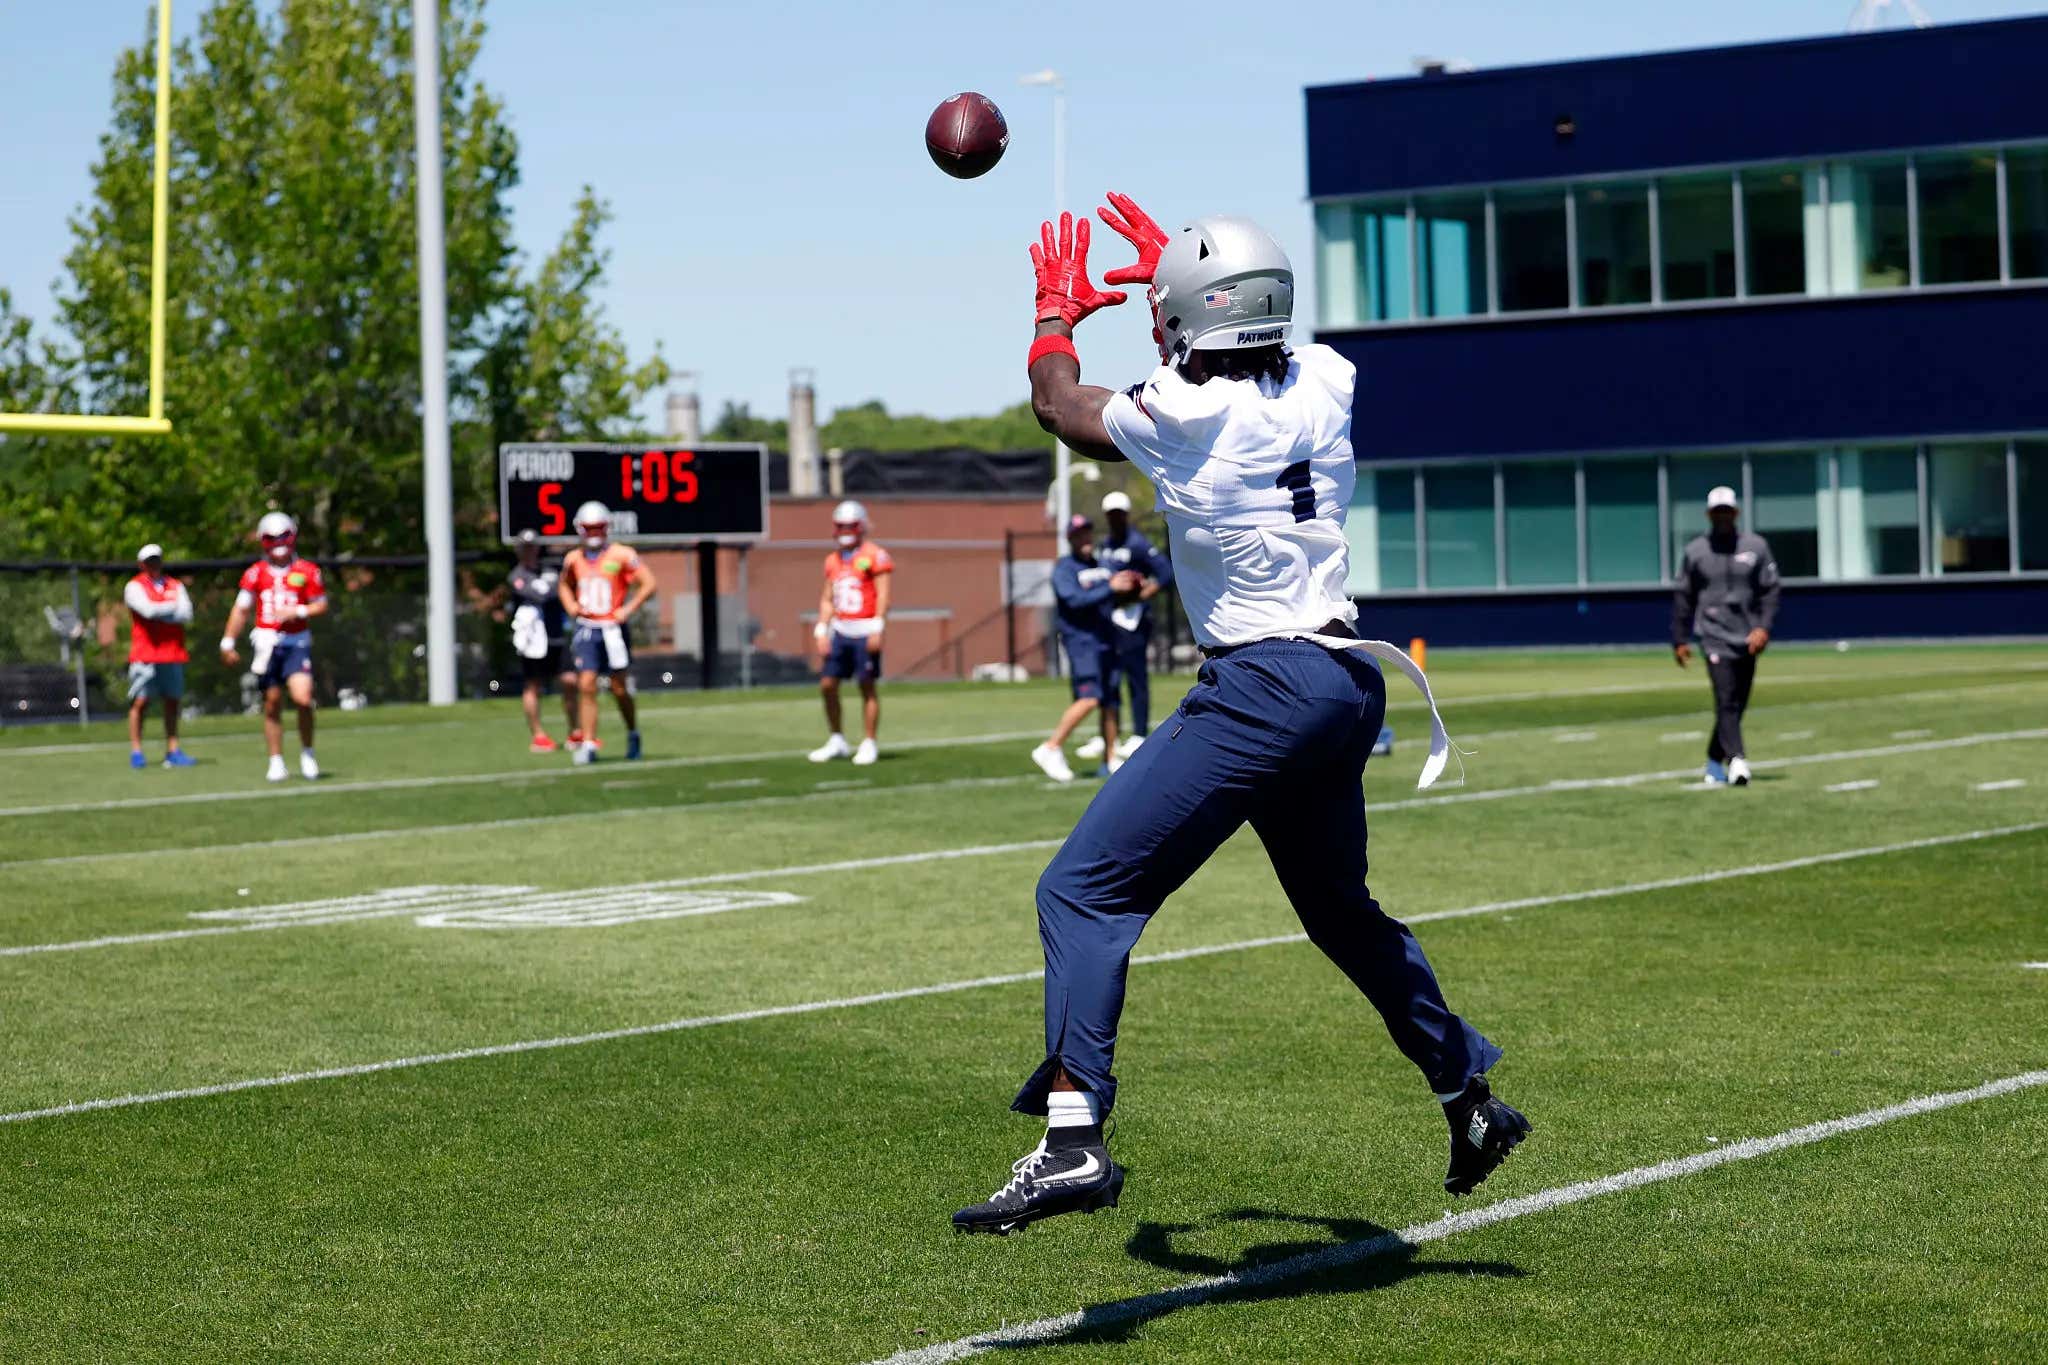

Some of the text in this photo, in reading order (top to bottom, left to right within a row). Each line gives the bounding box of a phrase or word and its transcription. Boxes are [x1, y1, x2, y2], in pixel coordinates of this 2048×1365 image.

[1266, 293, 1273, 316] 1
[1236, 327, 1285, 345] PATRIOTS
[506, 451, 575, 481] PERIOD
[621, 449, 699, 503] 1:05
[537, 482, 567, 535] 5
[1275, 459, 1317, 524] 1
